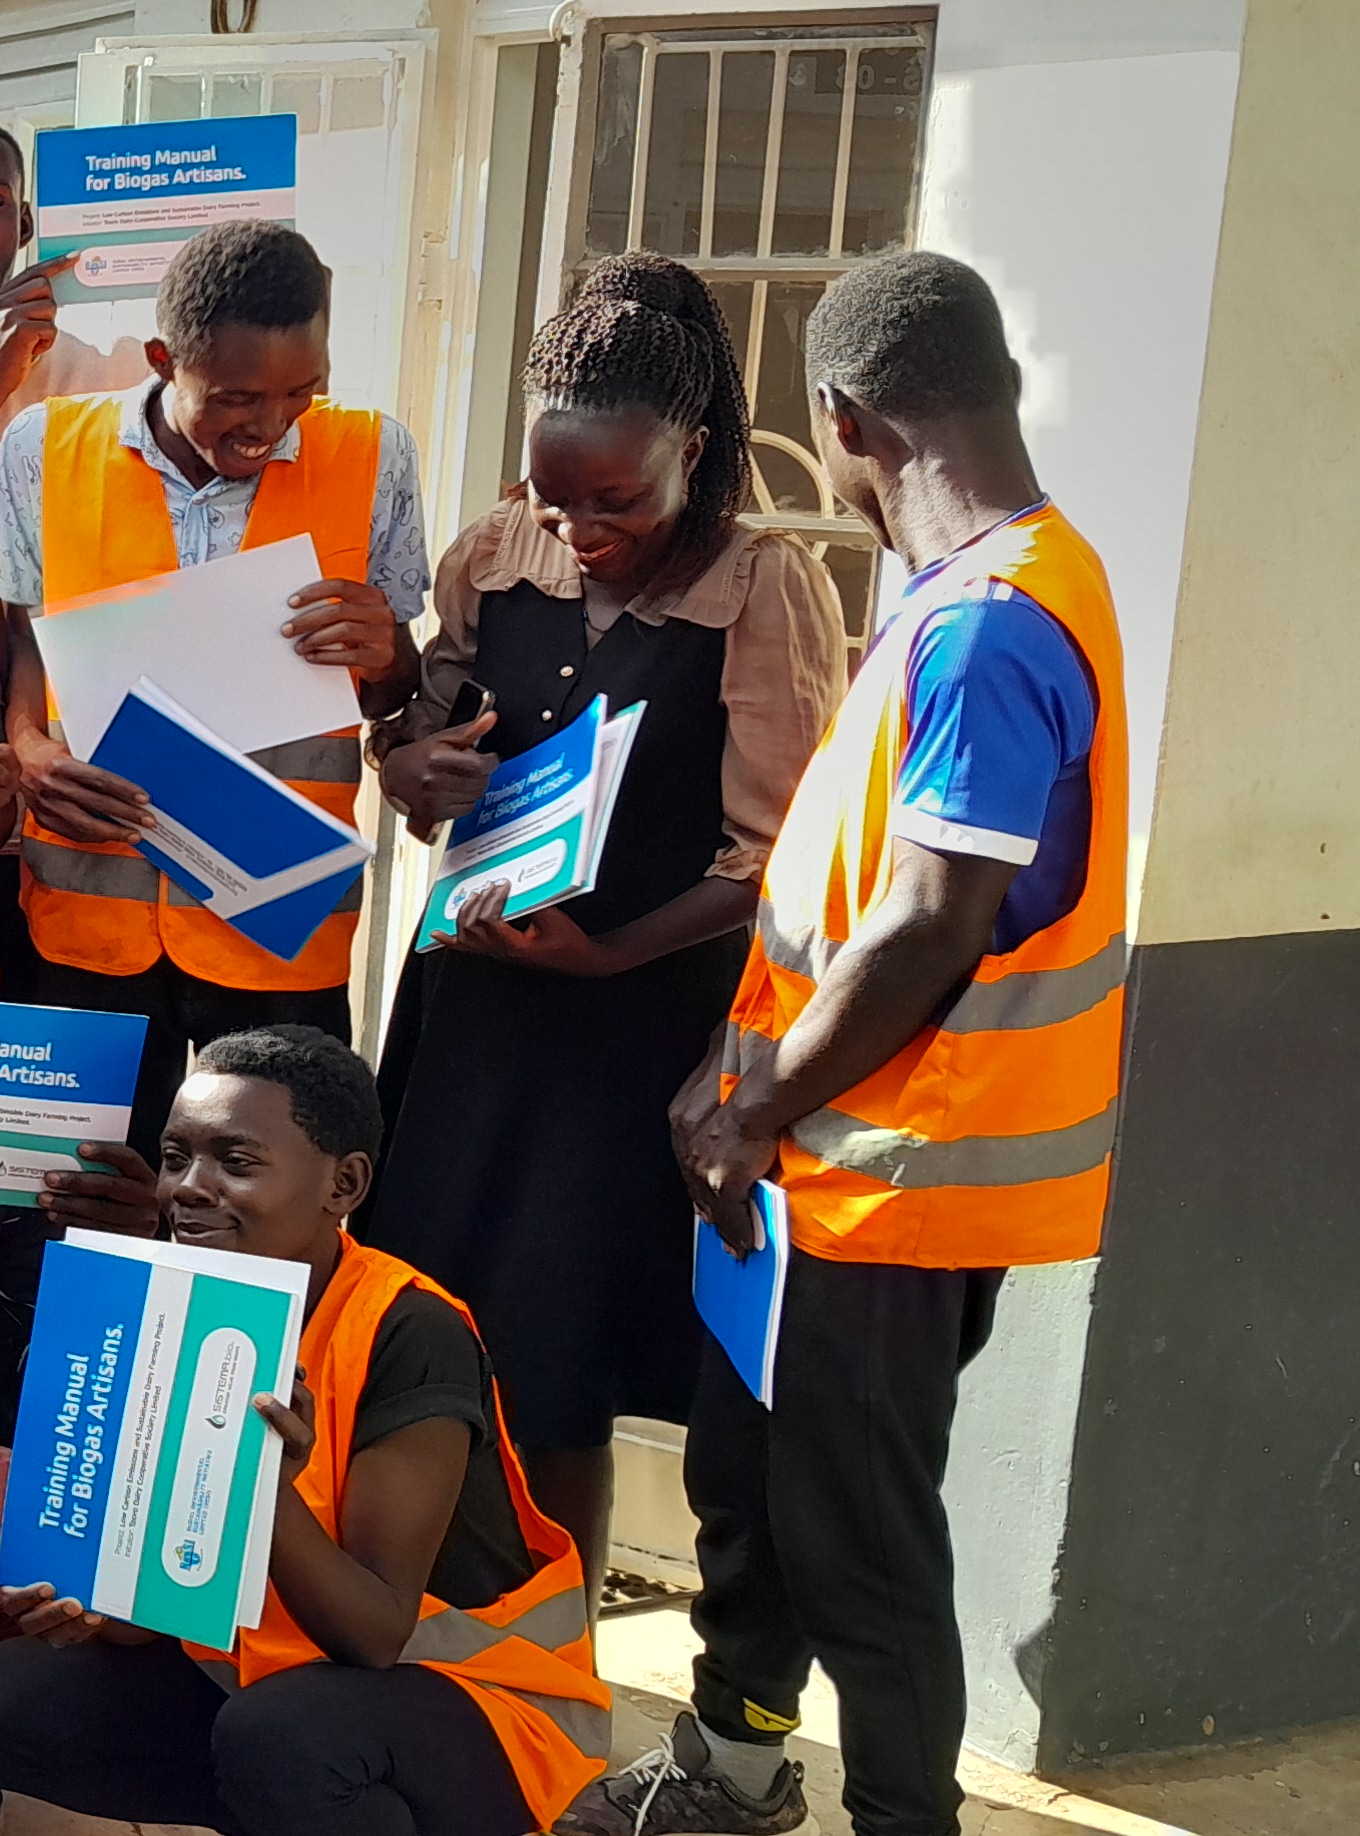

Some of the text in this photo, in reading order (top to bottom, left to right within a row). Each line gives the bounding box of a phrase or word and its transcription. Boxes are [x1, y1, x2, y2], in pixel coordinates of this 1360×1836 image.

[85, 145, 216, 170] Training Manual
[85, 166, 246, 191] for Biogas Artisans.
[38, 1353, 89, 1526] Training Manual
[63, 1325, 123, 1537] for Biogas Artisans.
